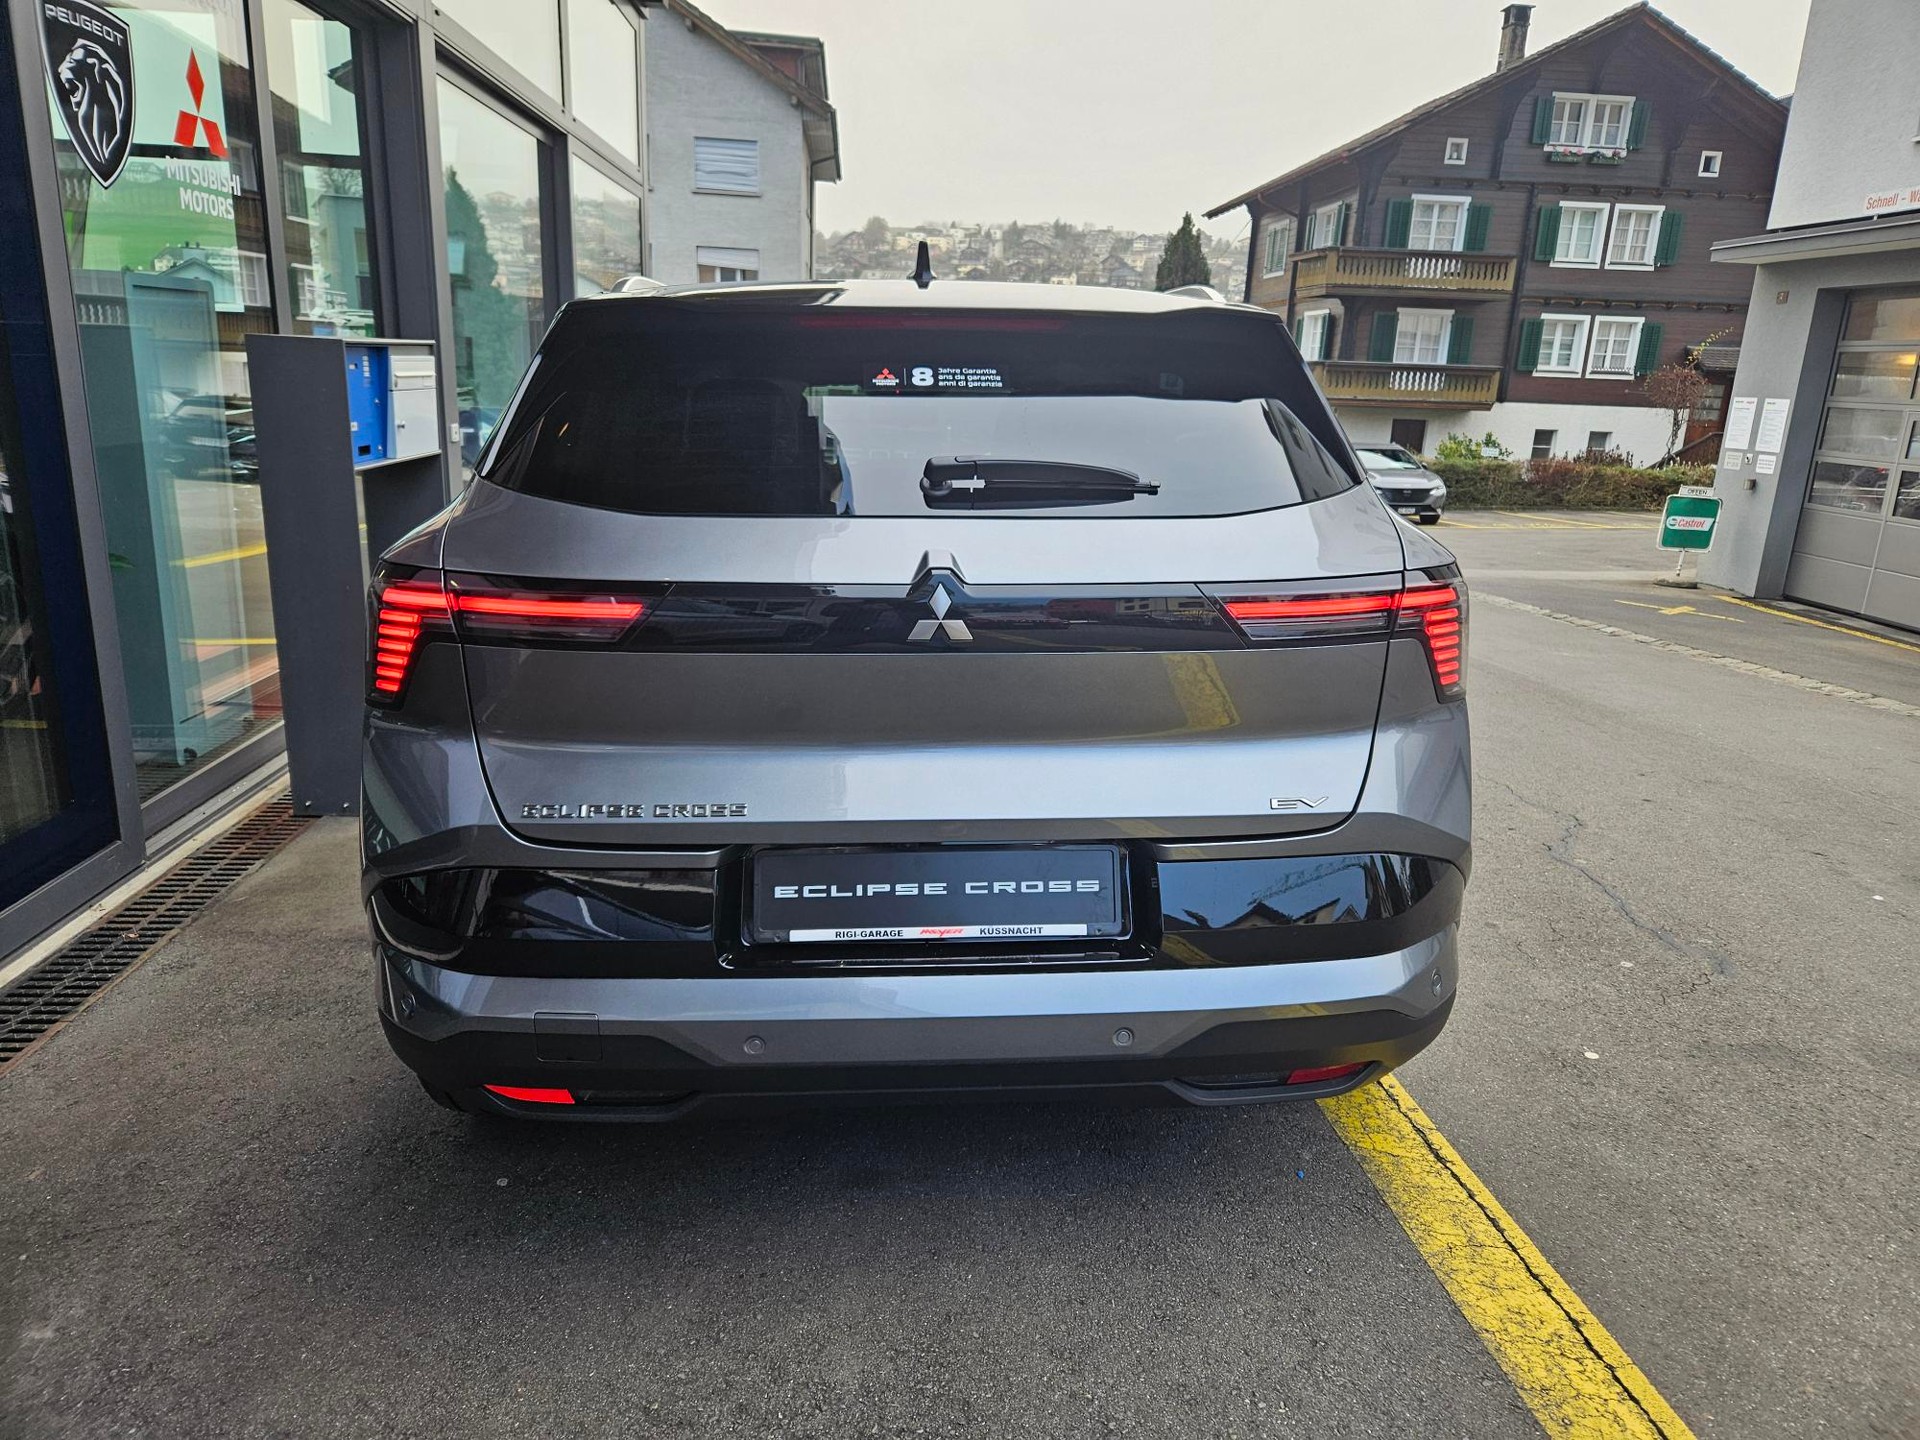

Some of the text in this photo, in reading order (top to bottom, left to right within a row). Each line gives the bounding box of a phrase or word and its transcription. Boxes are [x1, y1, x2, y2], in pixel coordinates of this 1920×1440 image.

[44, 4, 124, 47] PEUGEOT
[165, 155, 241, 197] MITSUBISHI
[179, 187, 234, 220] MOTORS
[1866, 192, 1899, 210] Schnell
[911, 366, 934, 387] 8
[1677, 517, 1706, 529] Castrol
[521, 802, 748, 819] ECLIPSE CROSS
[1269, 796, 1329, 810] EV
[774, 879, 1101, 899] ECLIPSE CROSS
[835, 929, 904, 939] RIGI-GARAGE
